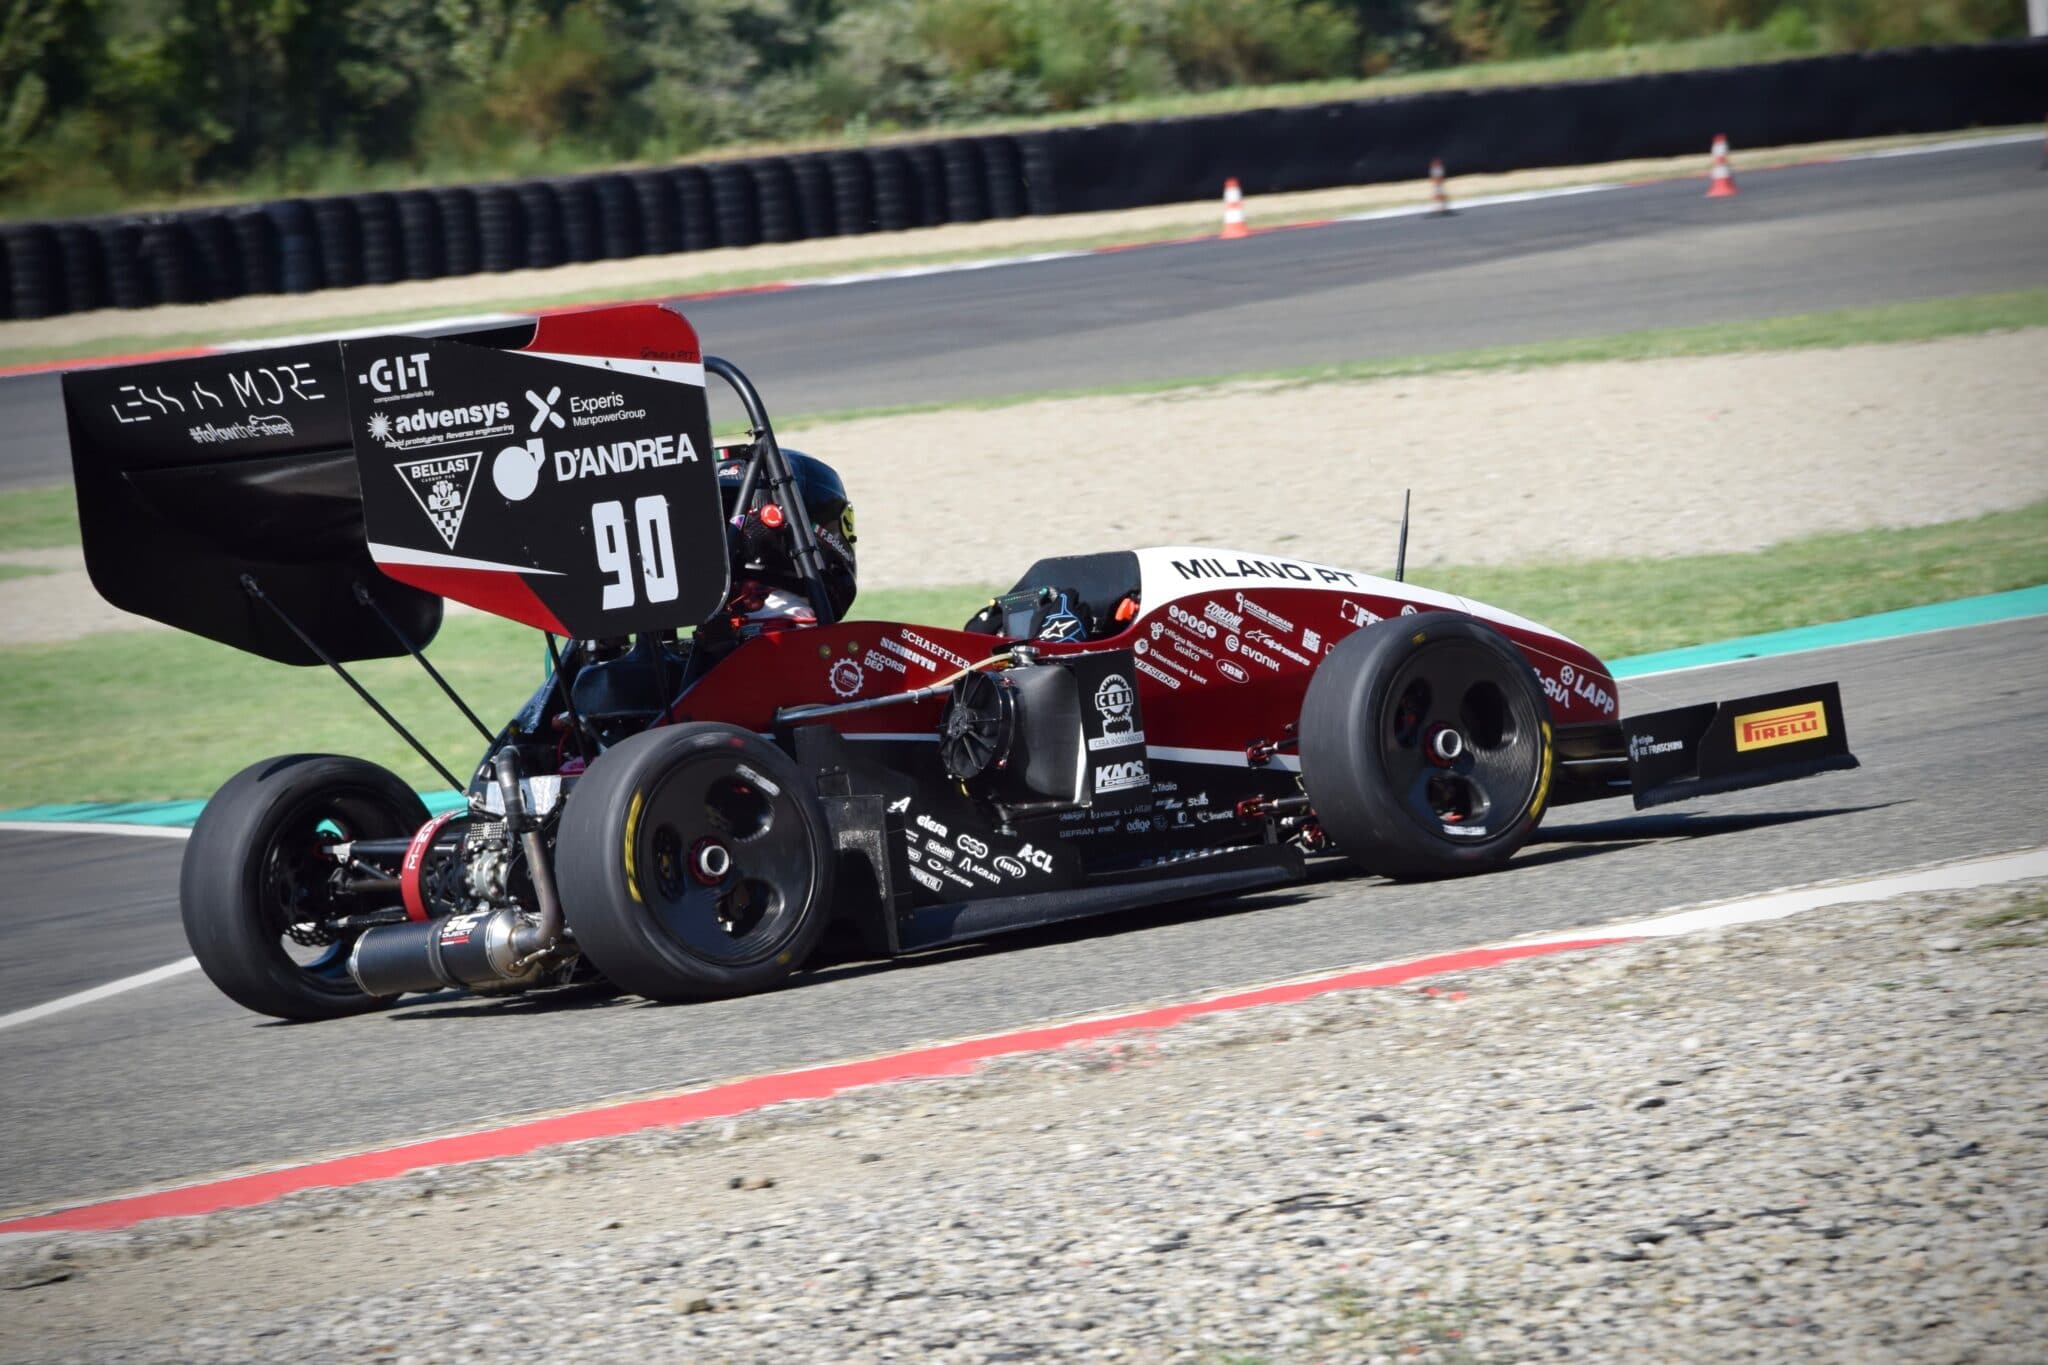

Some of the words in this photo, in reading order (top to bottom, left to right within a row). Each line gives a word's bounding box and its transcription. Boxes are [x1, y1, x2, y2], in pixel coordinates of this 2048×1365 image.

[570, 392, 625, 414] Experis
[395, 401, 510, 434] advensys
[572, 408, 647, 427] ManpowerGroup
[410, 458, 469, 479] BELLASI
[553, 432, 698, 482] D'ANDREA
[591, 494, 679, 610] 90
[1171, 558, 1312, 582] MILANO
[900, 628, 971, 669] SCHAEFFLER
[1150, 648, 1188, 675] Dimensione
[1174, 642, 1200, 661] Gualco
[1240, 644, 1280, 672] EVONIK
[1098, 690, 1131, 707] CEBA
[1574, 675, 1615, 715] LAPP
[1743, 710, 1818, 743] PIRELLI
[1095, 760, 1145, 788] KAOS
